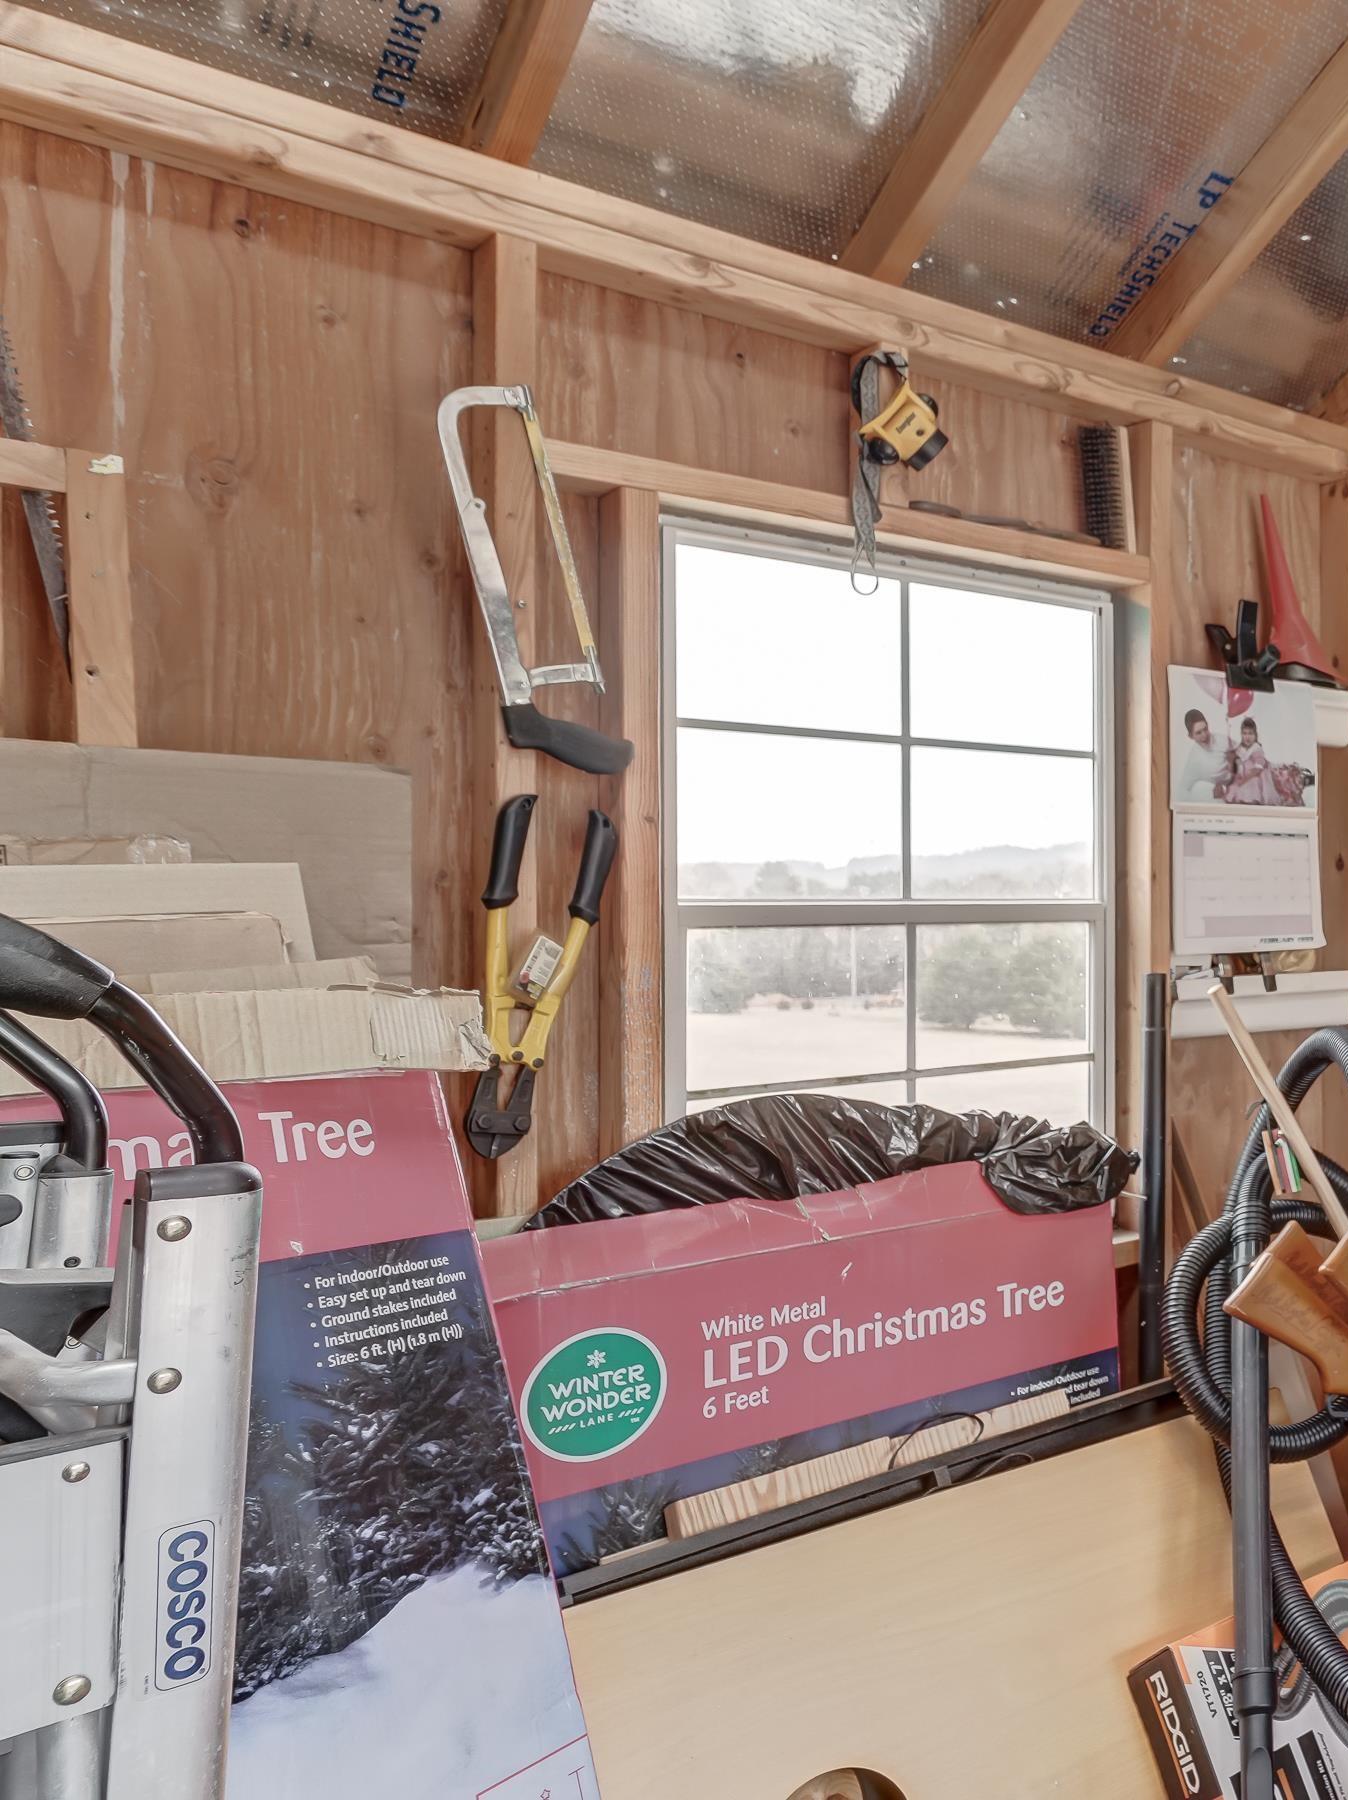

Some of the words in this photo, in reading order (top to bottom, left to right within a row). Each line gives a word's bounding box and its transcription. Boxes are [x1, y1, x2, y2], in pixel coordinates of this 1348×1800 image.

[1197, 170, 1235, 210] LP
[257, 1110, 376, 1164] Tree
[314, 1276, 338, 1290] For
[430, 1256, 449, 1270] use
[318, 1294, 347, 1310] Easy
[350, 1288, 369, 1303] set
[371, 1286, 387, 1300] up
[388, 1281, 411, 1296] and
[412, 1277, 434, 1291] tear
[436, 1270, 467, 1285] down
[321, 1306, 371, 1328] Ground
[372, 1298, 409, 1317] stakes
[410, 1288, 457, 1309] included
[324, 1323, 399, 1348] Instructions
[400, 1308, 449, 1330] included
[700, 1312, 765, 1341] White
[770, 1295, 827, 1328] Metal
[327, 1353, 359, 1368] Size:
[360, 1346, 370, 1359] 6
[371, 1342, 387, 1357] ft.
[387, 1336, 406, 1355] (H)
[428, 1330, 441, 1342] m
[703, 1334, 789, 1390] LED
[803, 1297, 987, 1364] Christmas
[996, 1280, 1066, 1319] Tree
[547, 1363, 645, 1400] WINTER
[540, 1383, 652, 1423] WONDER
[579, 1413, 615, 1429] LANE
[702, 1395, 717, 1420] 6
[724, 1385, 770, 1414] Feet
[164, 1530, 209, 1681] COSCO
[1196, 1670, 1219, 1719] VT1720
[1149, 1670, 1201, 1795] RIDGID
